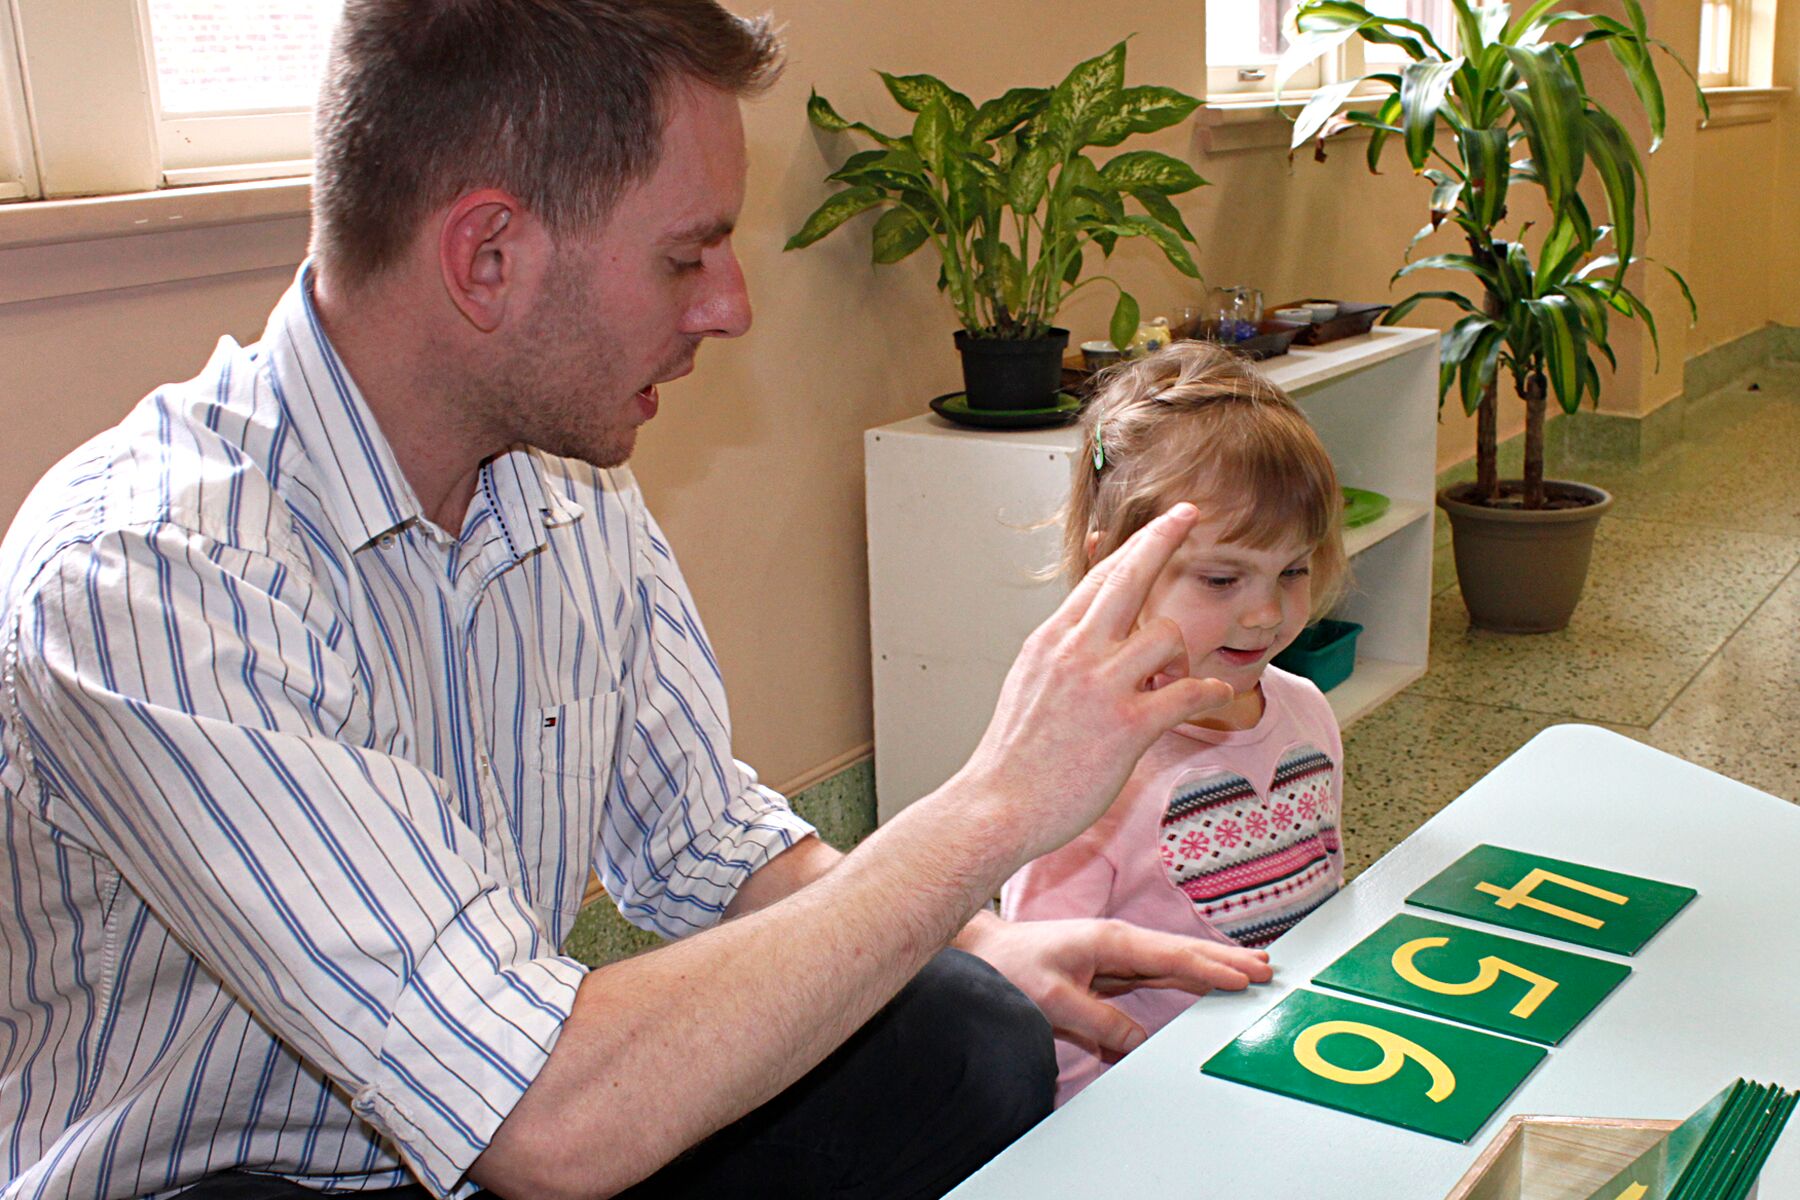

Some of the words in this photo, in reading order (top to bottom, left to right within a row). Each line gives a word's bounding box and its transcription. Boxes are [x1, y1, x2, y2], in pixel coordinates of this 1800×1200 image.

[1475, 868, 1629, 929] 4
[1391, 937, 1558, 1019] 5
[1293, 1020, 1456, 1103] 6
